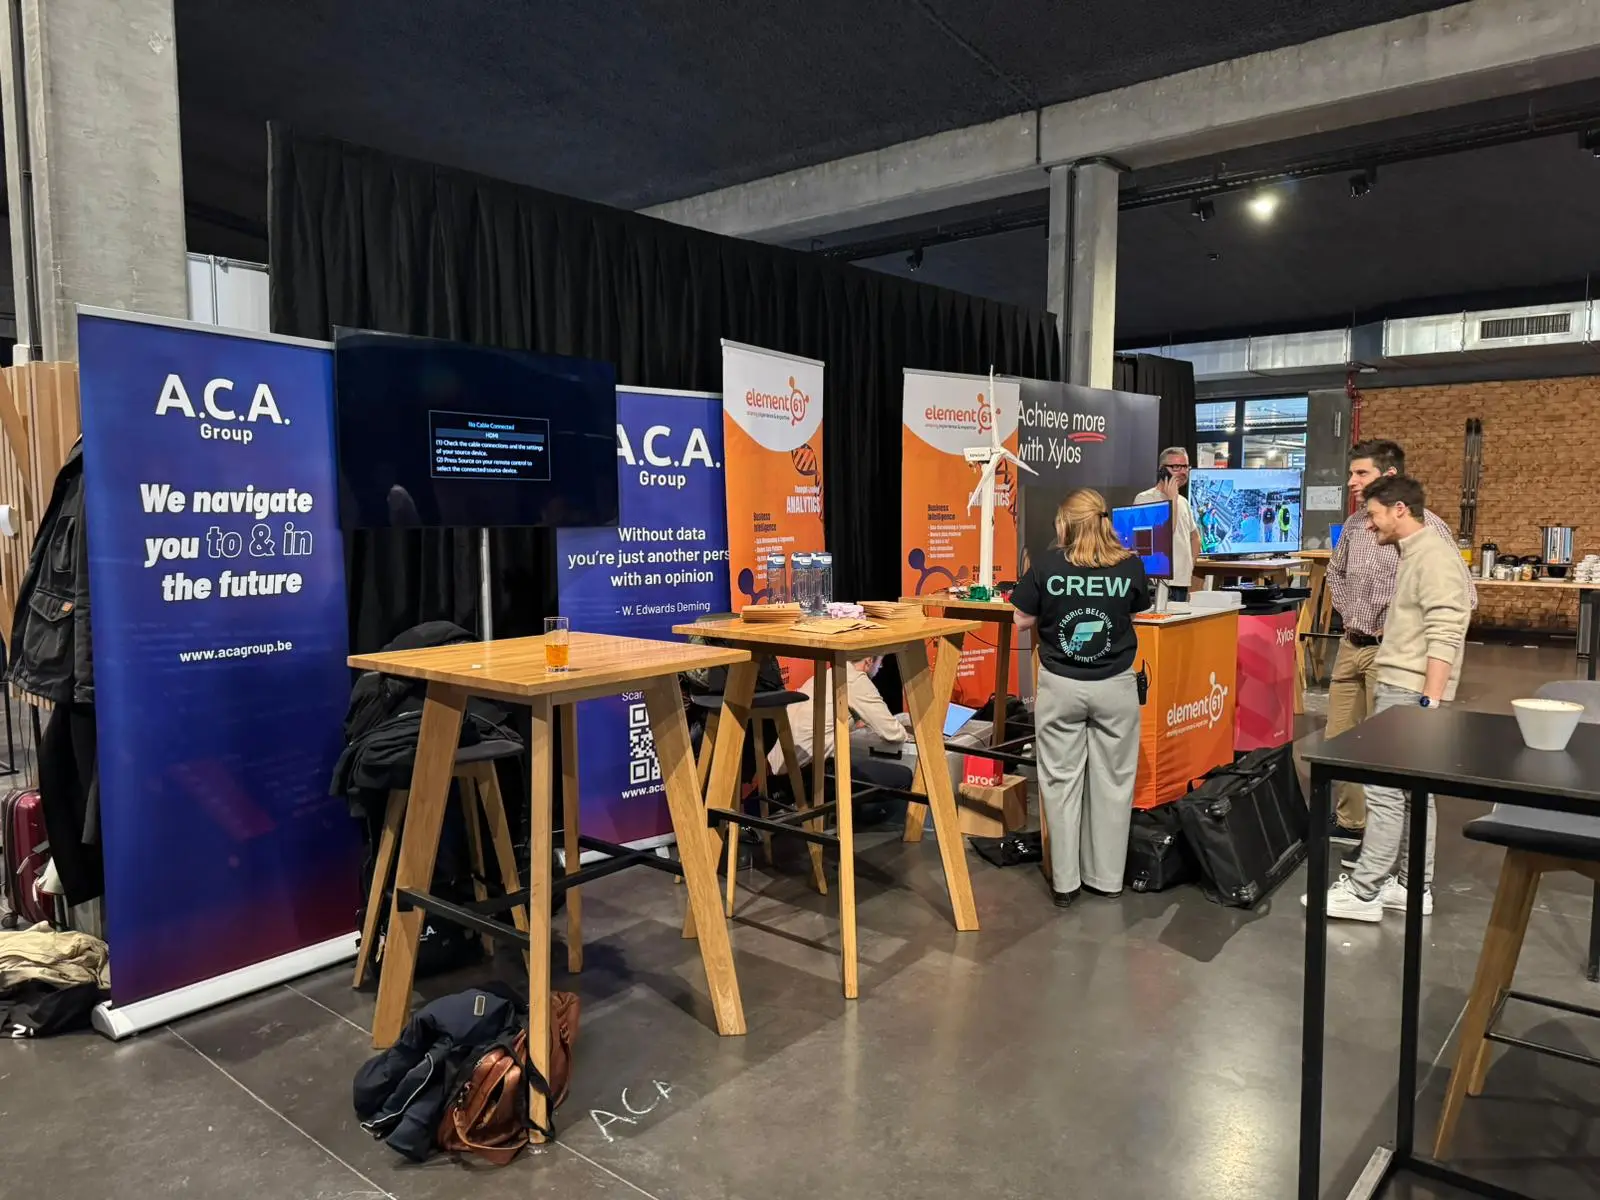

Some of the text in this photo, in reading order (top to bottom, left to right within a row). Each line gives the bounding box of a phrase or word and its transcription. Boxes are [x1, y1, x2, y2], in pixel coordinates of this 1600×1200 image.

[156, 374, 291, 425] A.C.A.
[1018, 400, 1105, 432] Achieve more
[200, 423, 252, 444] Group
[616, 423, 720, 468] A.C.A.
[1018, 436, 1081, 469] with Xylos
[639, 471, 686, 489] Group
[140, 484, 313, 519] We navigate
[786, 496, 820, 513] ANALYTICS
[144, 522, 312, 568] you to & in
[618, 527, 705, 541] Without data
[618, 551, 644, 568] just
[648, 549, 700, 563] another
[162, 571, 302, 601] the future
[611, 570, 713, 587] with an opinion
[1047, 575, 1131, 597] CREW
[622, 606, 634, 616] W.
[637, 602, 675, 615] Edwards
[677, 601, 710, 614] Deming
[1059, 608, 1112, 629] FABRIC BELGIUM
[1276, 627, 1294, 646] Xylos
[180, 640, 292, 662] www.acagroup.be
[590, 1079, 672, 1142] ACA
